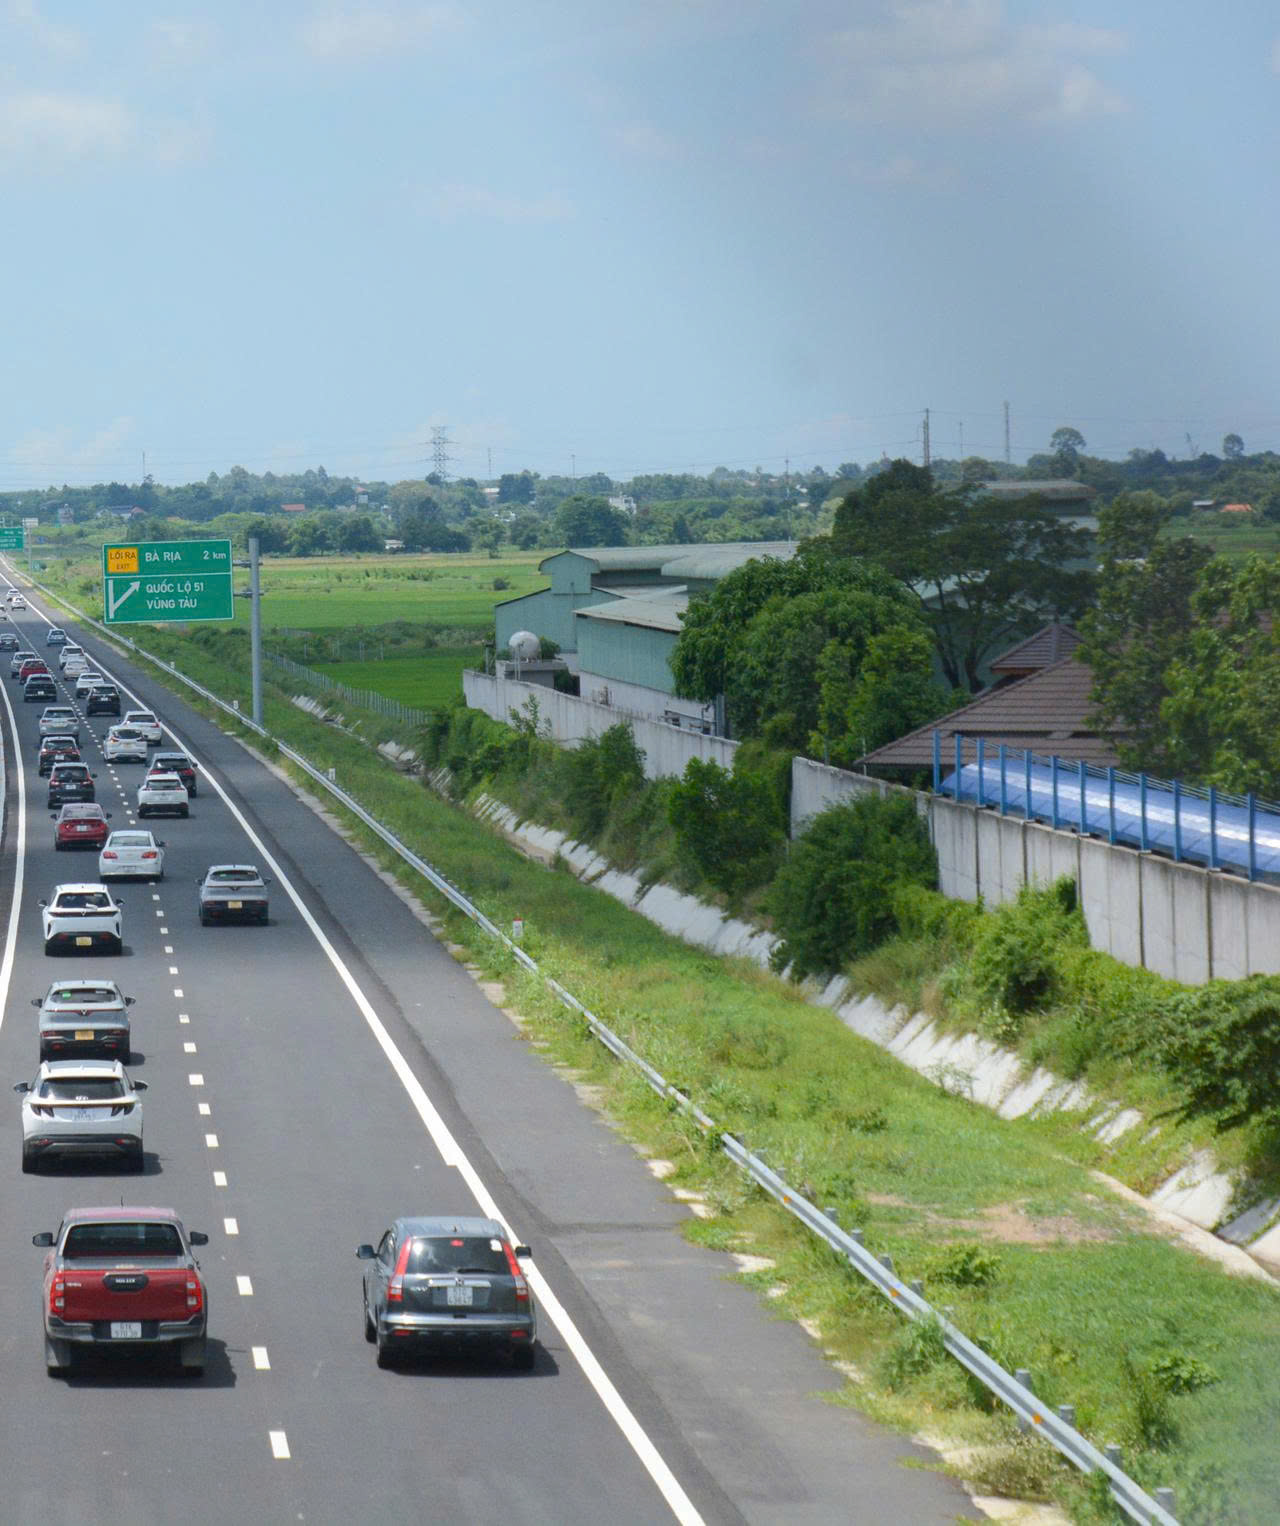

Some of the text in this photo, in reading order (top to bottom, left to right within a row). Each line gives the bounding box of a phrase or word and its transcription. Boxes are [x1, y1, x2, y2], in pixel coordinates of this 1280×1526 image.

[125, 551, 136, 560] RA
[145, 549, 182, 563] BÀ RỊA
[203, 550, 227, 560] 2 km
[146, 579, 204, 594] QUỐC LỘ 51
[146, 596, 197, 609] VŨNG TÀU
